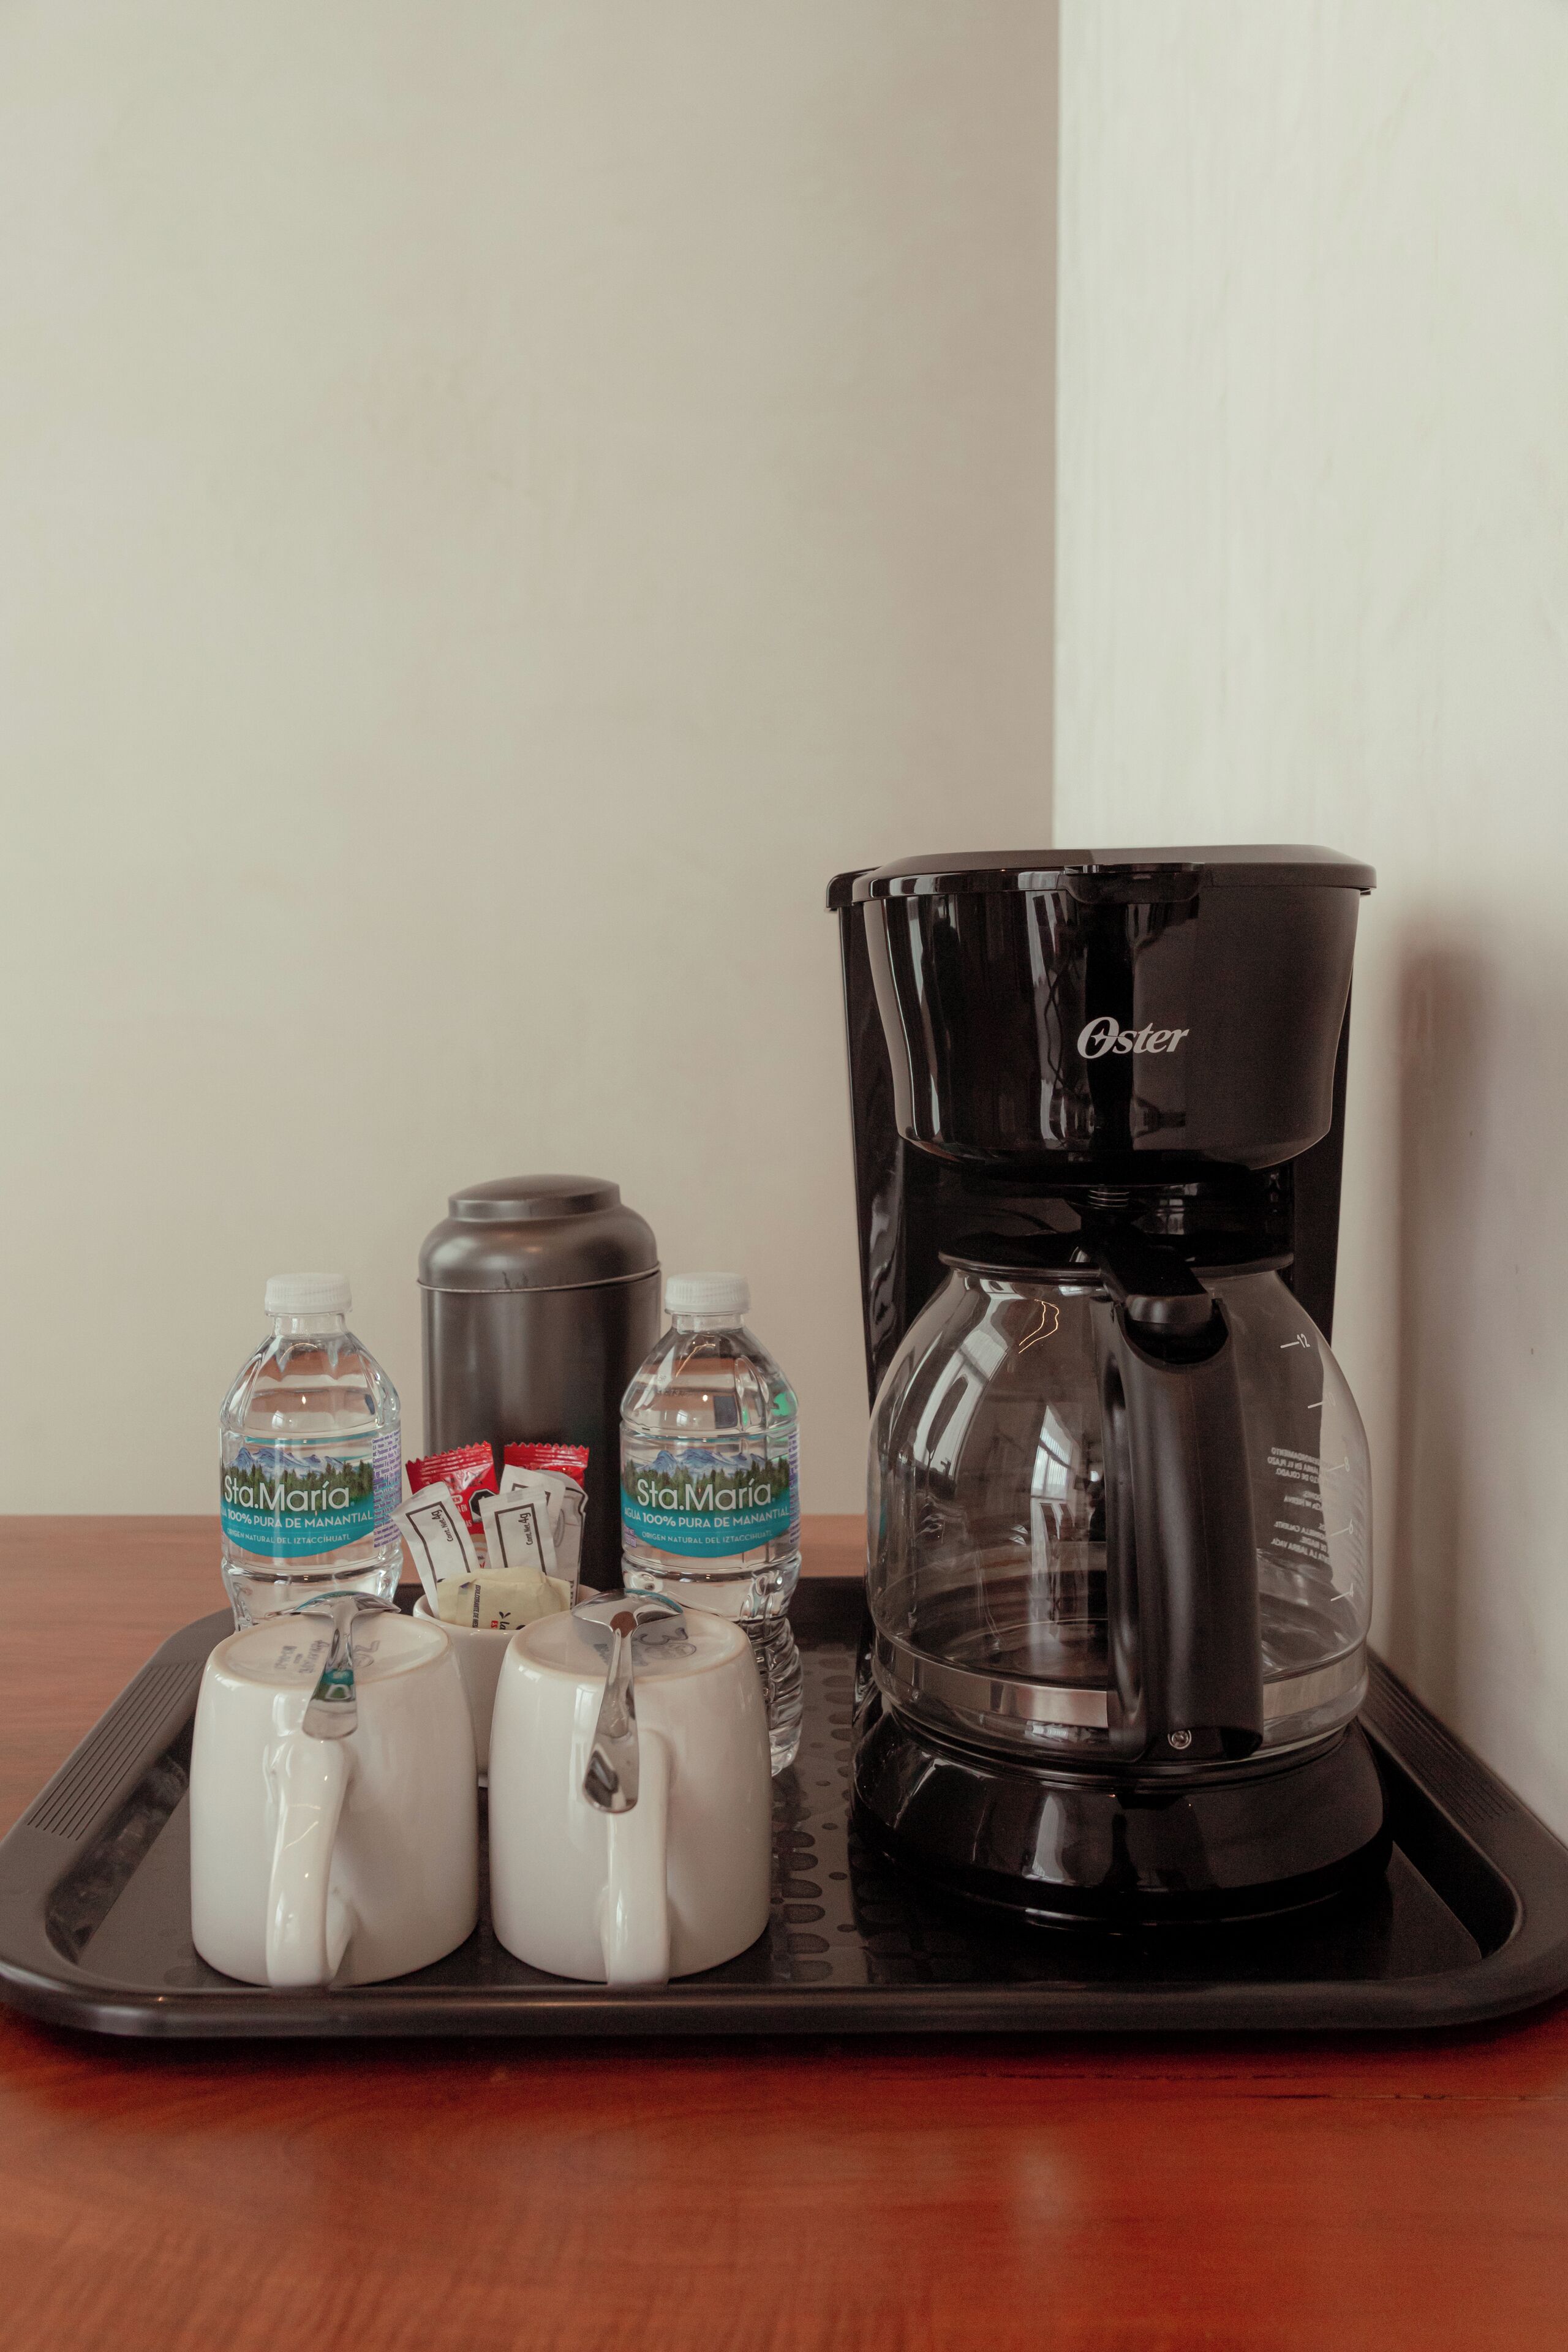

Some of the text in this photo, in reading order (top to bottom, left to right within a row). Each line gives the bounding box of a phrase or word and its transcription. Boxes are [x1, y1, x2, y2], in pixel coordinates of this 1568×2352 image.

[1077, 1017, 1189, 1059] Oster
[1297, 1333, 1311, 1348] 12
[1344, 1457, 1351, 1472] 8
[228, 1509, 252, 1525] 100%
[254, 1515, 282, 1528] PURA
[285, 1518, 301, 1528] DE
[304, 1510, 373, 1528] MANANTIAL
[624, 1506, 790, 1528] AGUA 100% PURA DE MANANTIAL
[1349, 1519, 1354, 1534] 6
[227, 1528, 244, 1538] ORIGEN
[245, 1534, 276, 1544] NATURAL
[641, 1531, 666, 1541] ORIGEN
